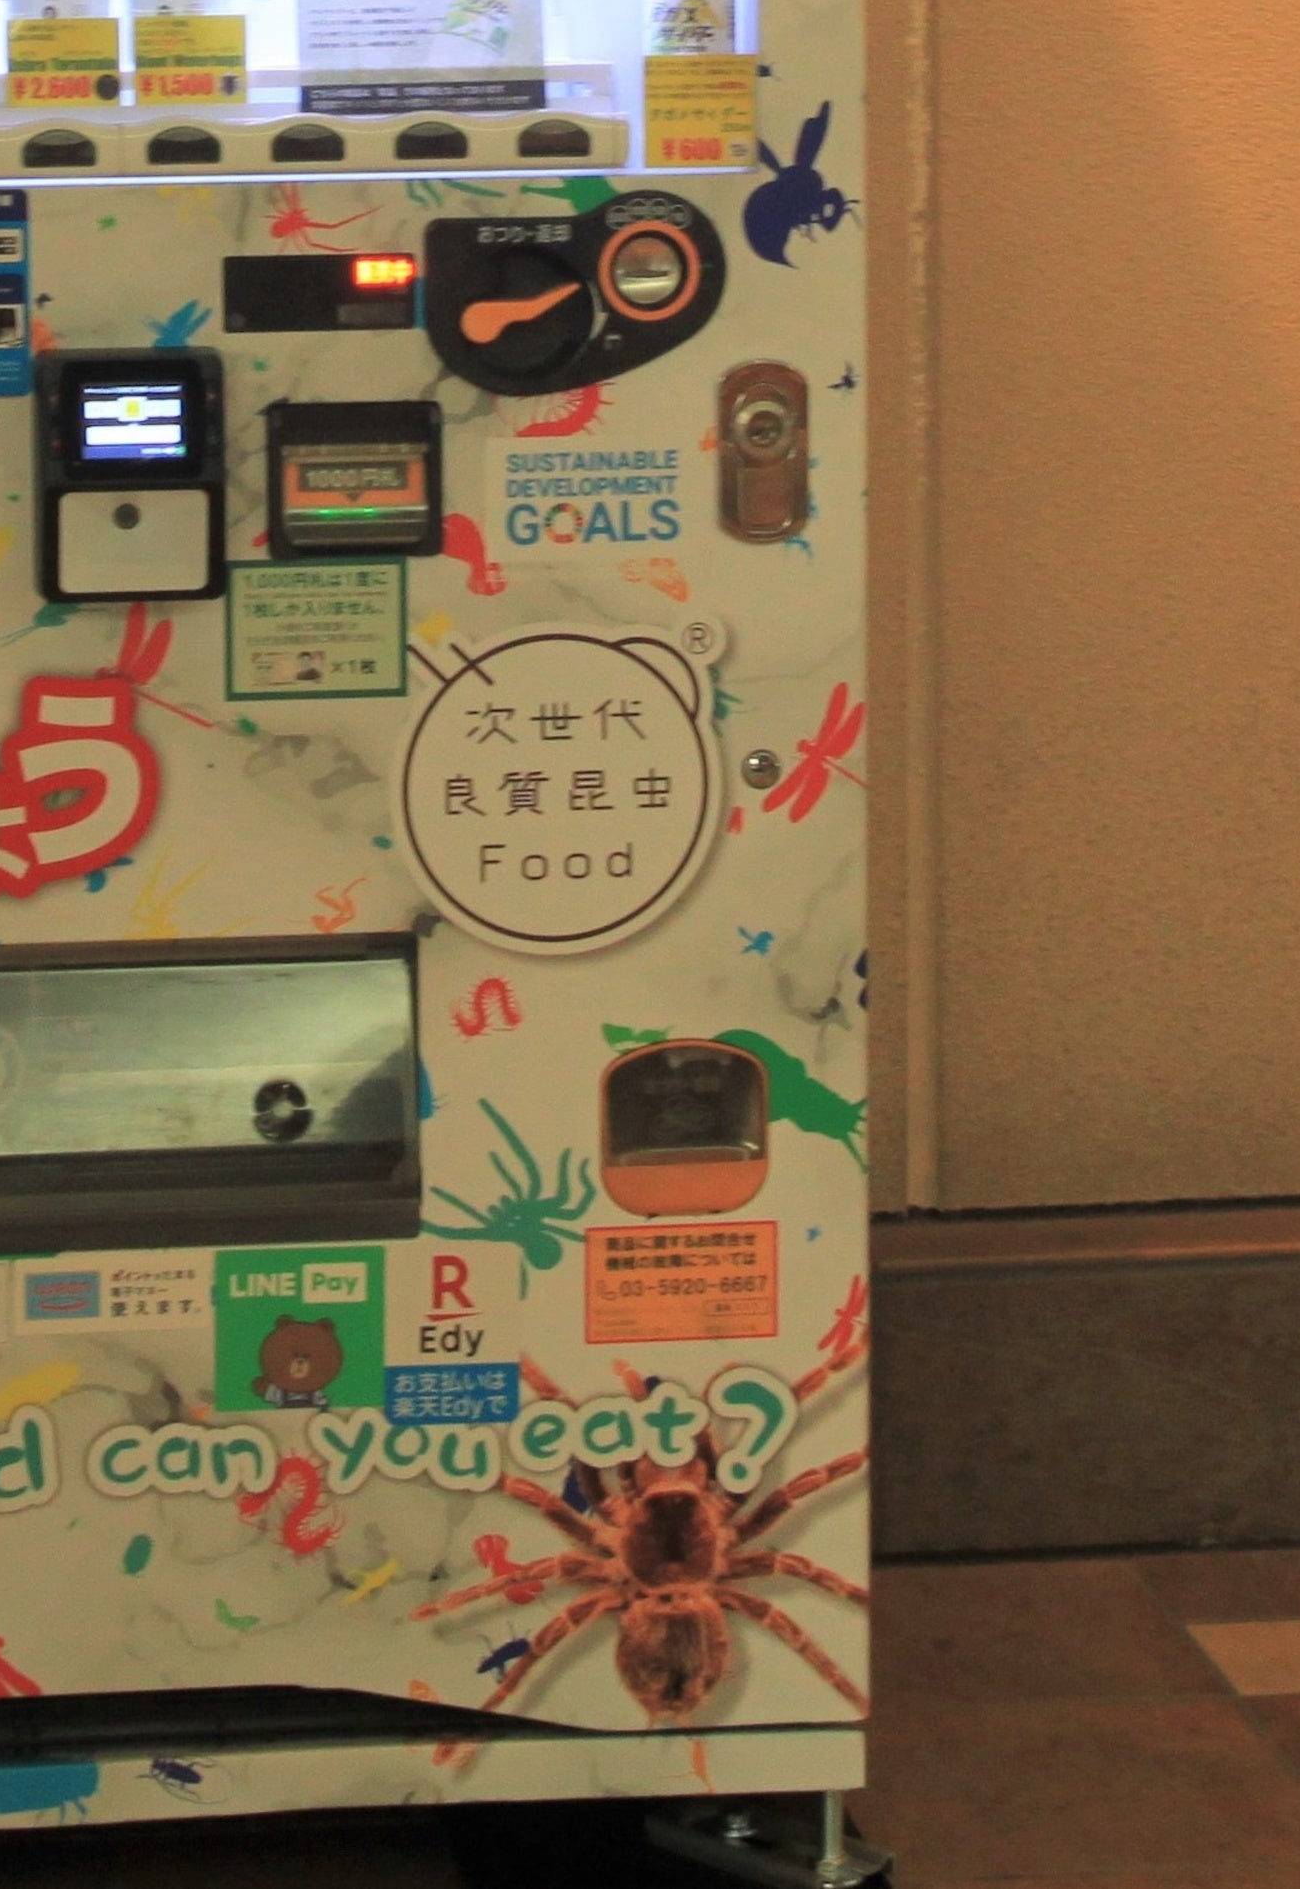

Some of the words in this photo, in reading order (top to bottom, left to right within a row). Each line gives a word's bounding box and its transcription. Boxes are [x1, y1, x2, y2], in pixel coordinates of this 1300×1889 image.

[305, 467, 401, 489] 1000円札
[506, 451, 679, 474] SUSTAINABLE
[506, 476, 678, 498] DEVELOPMENT
[506, 499, 682, 545] GOALS
[466, 699, 647, 744] 次世代
[444, 768, 672, 817] 良質昆虫
[479, 842, 635, 883] Food
[230, 1272, 297, 1299] LINE
[310, 1270, 360, 1297] Pay
[419, 1325, 486, 1358] Edy
[392, 1370, 508, 1397] お支払いは
[391, 1393, 511, 1421] 楽天Edyで
[101, 1424, 265, 1486] can
[325, 1419, 488, 1480] you
[521, 1379, 788, 1481] eat?
